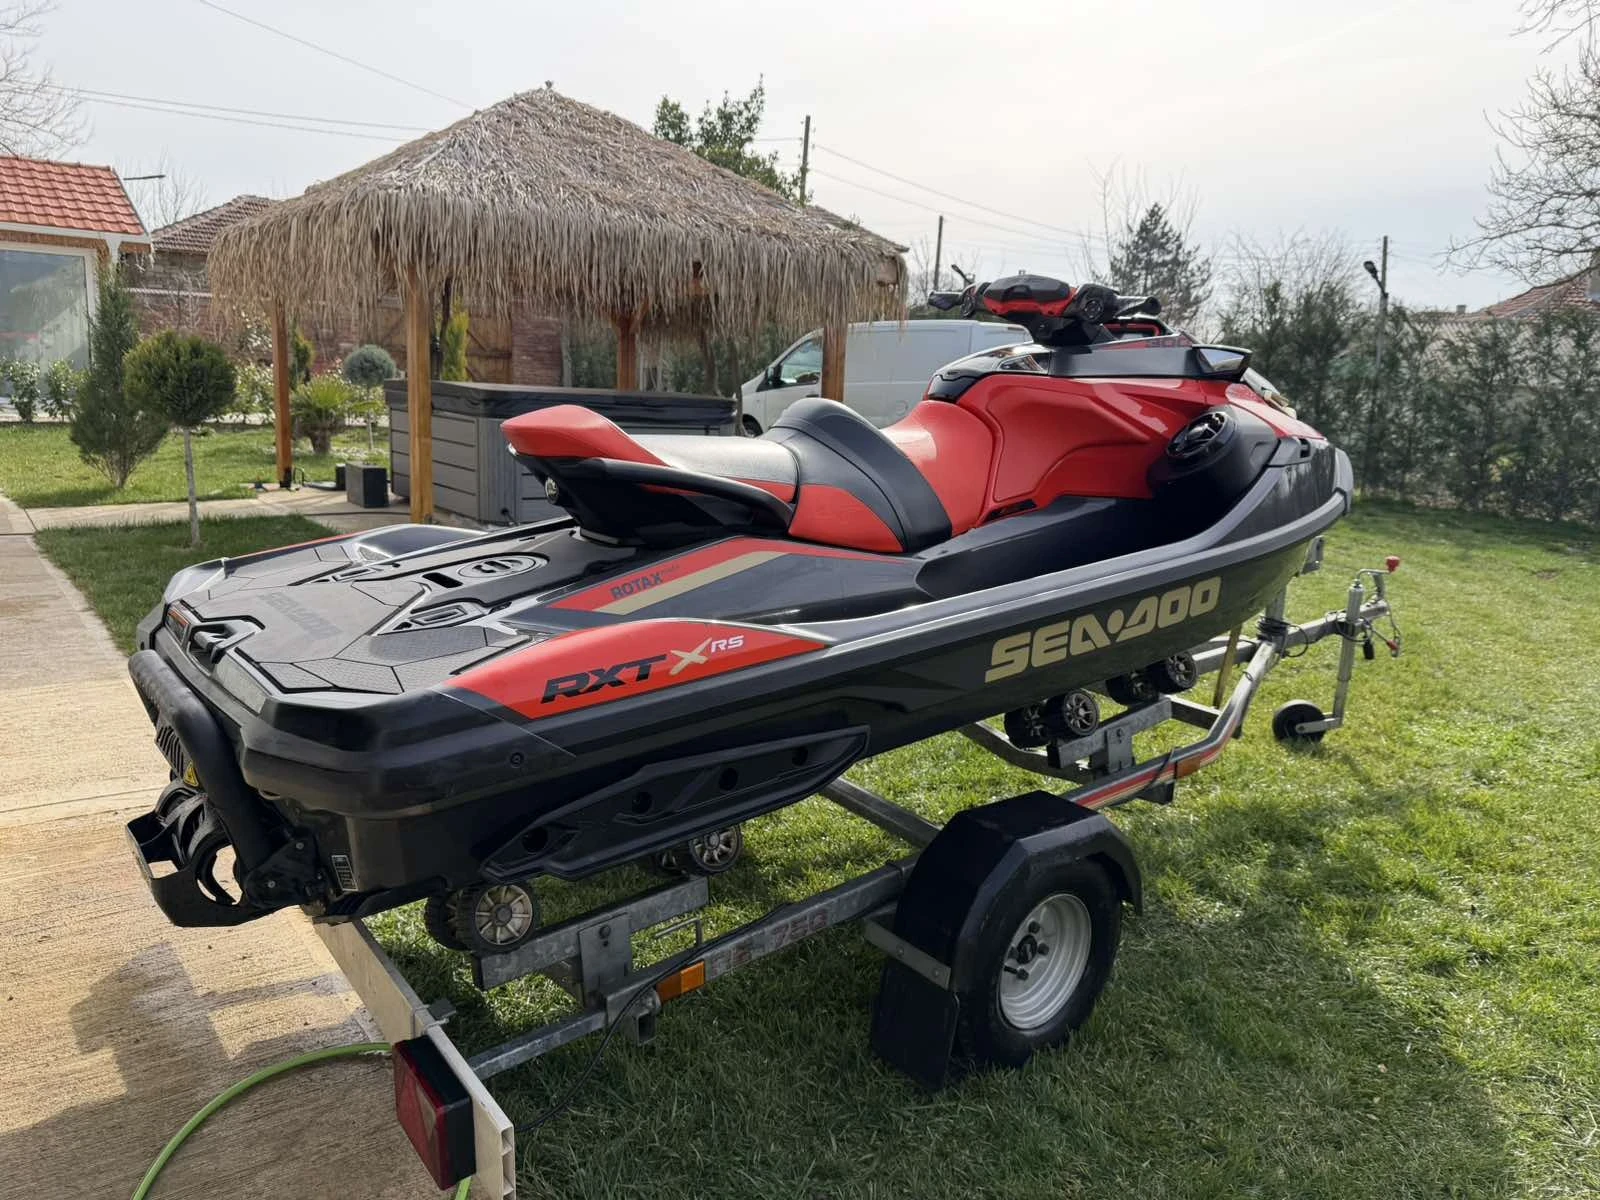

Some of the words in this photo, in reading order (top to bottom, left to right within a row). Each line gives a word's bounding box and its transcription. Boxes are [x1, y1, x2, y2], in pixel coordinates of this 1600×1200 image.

[610, 572, 664, 601] ROTAX
[541, 653, 667, 704] RXT
[669, 637, 713, 676] X
[711, 635, 745, 653] RS
